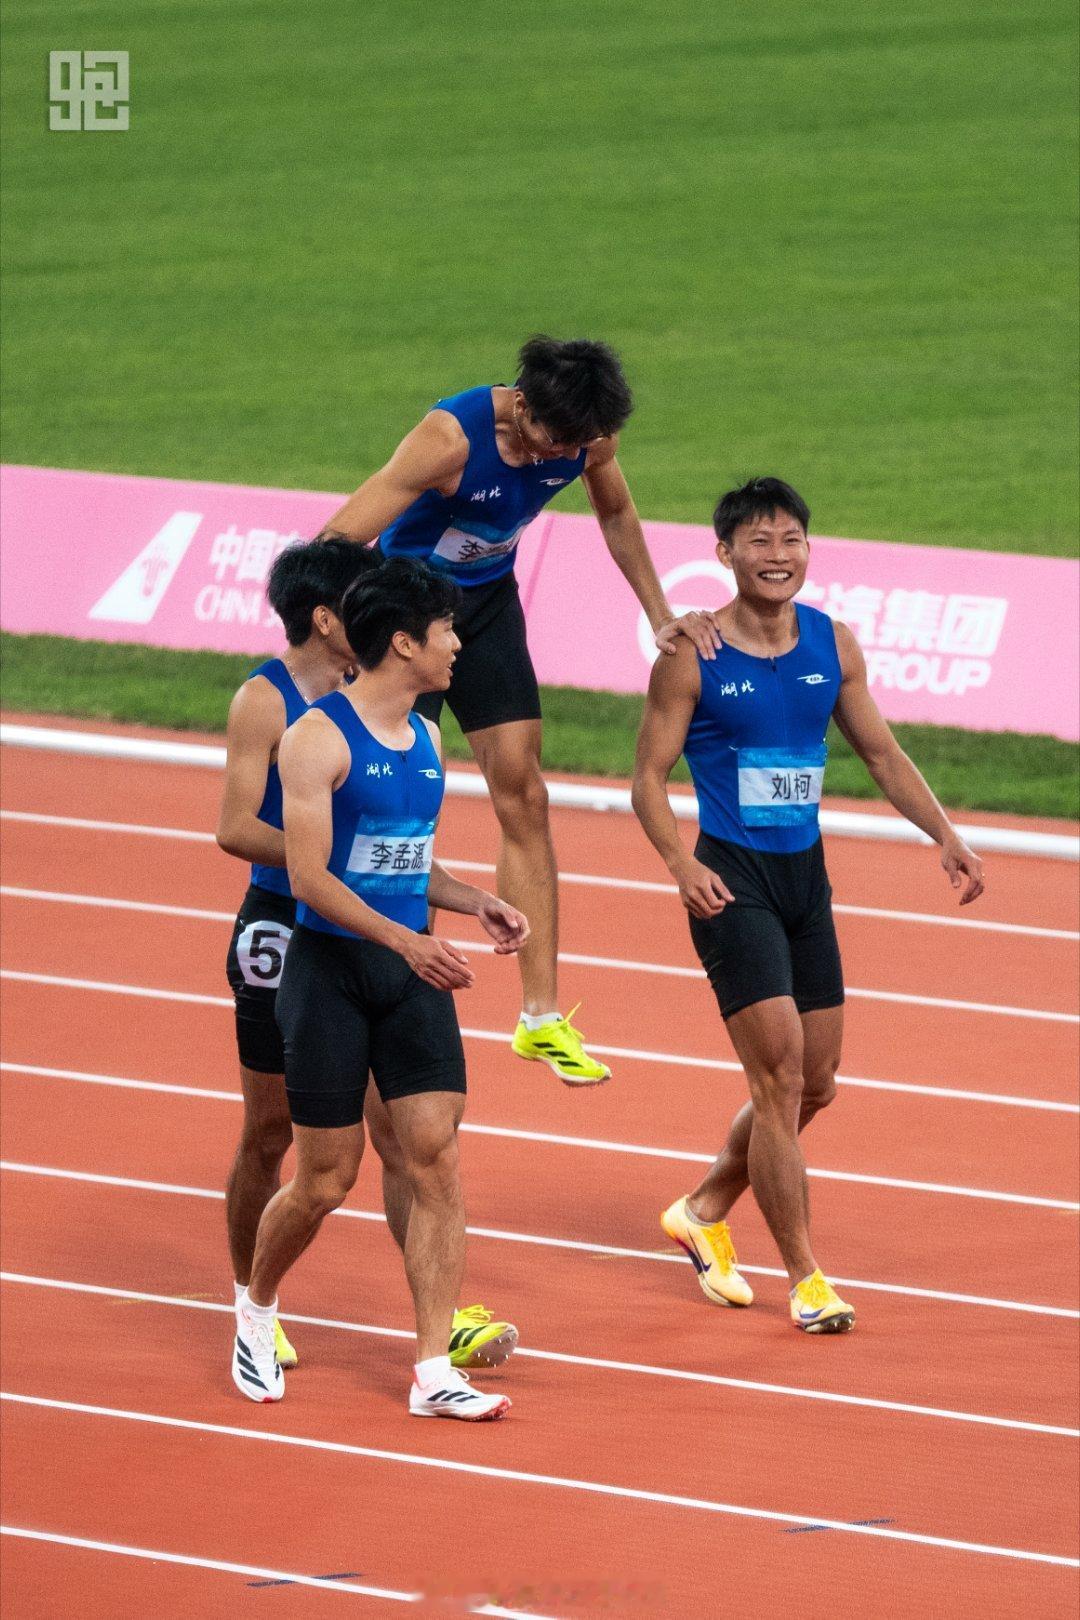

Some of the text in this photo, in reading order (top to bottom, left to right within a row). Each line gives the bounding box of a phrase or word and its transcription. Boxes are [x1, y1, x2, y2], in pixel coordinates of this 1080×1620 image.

[470, 485, 502, 502] 湖北
[796, 579, 1009, 657] 汽集团
[864, 650, 991, 695] ROUP
[720, 679, 756, 697] 湖北
[366, 762, 394, 779] 湖北
[771, 772, 812, 801] 刘柯
[249, 929, 282, 980] 5
